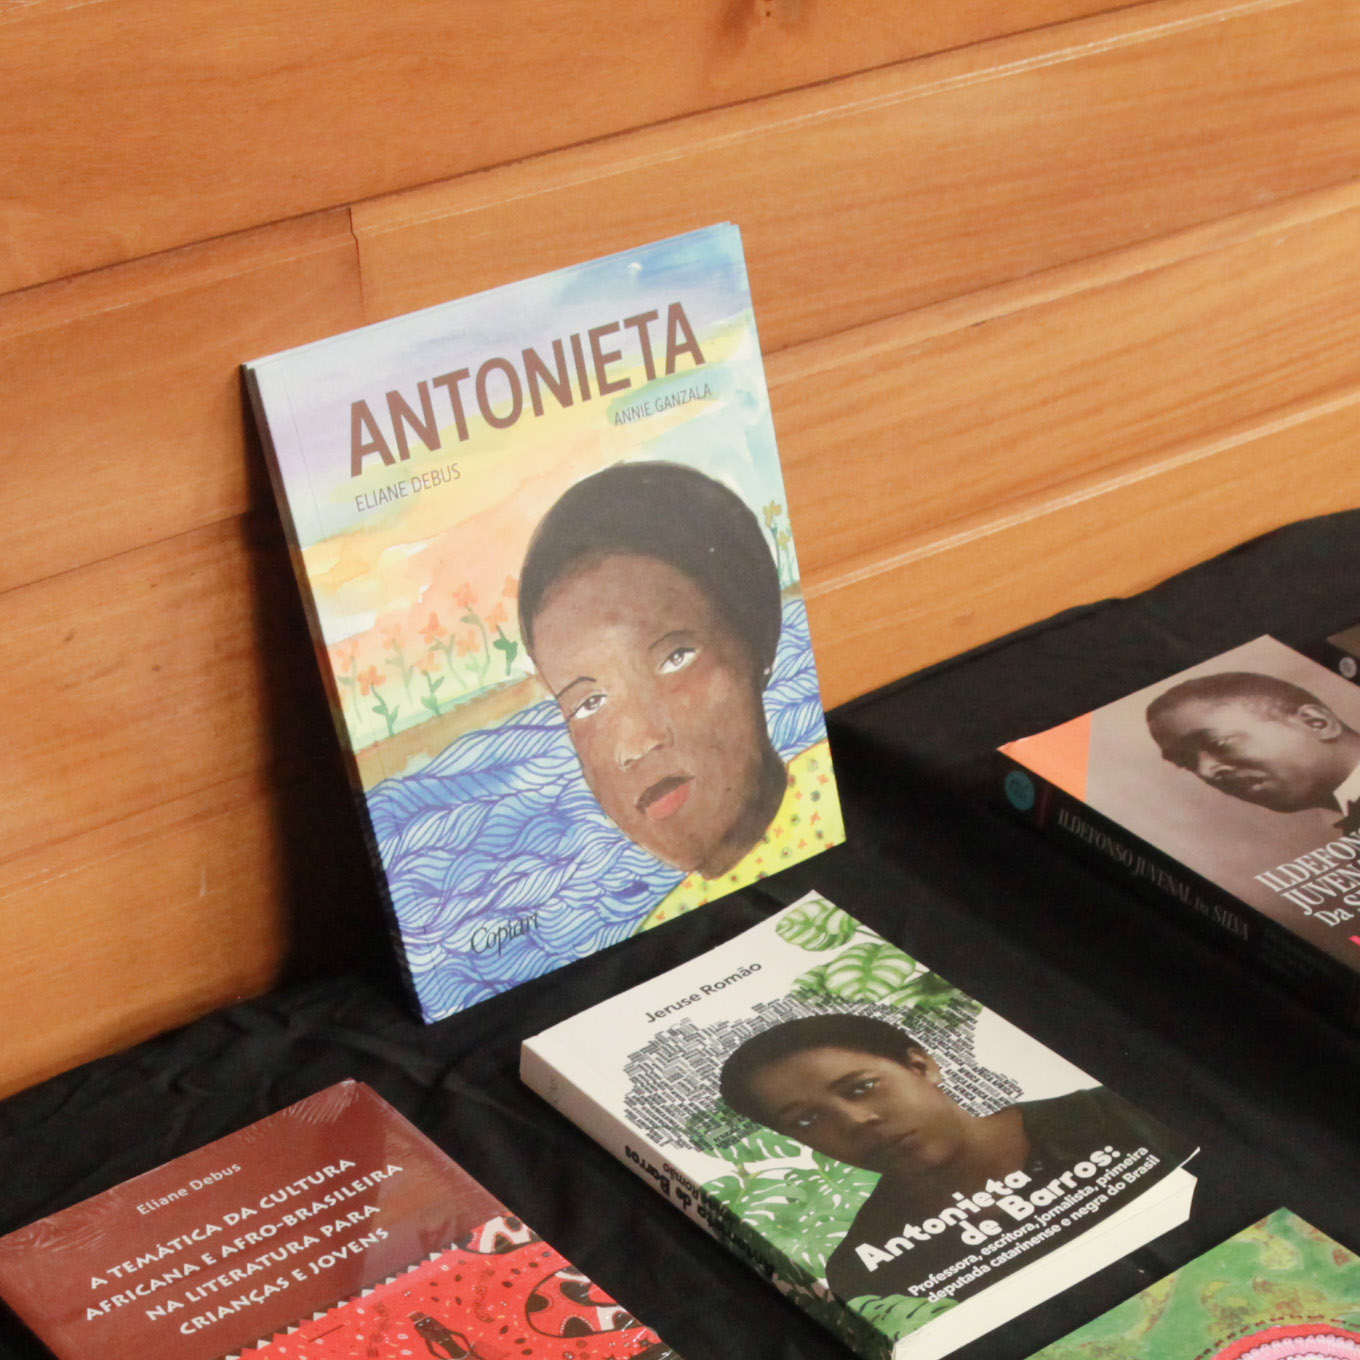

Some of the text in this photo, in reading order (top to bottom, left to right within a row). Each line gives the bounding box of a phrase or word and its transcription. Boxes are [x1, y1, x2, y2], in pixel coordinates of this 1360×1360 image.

[350, 301, 706, 478] ANTONIETA
[614, 383, 713, 427] ANNIE GANZALA
[355, 462, 461, 512] ELIANE DEBUS
[1057, 809, 1133, 867] ILDEFONSO
[1131, 855, 1192, 904] JUVENAL
[470, 910, 539, 956] Copiart
[645, 960, 762, 1023] Jeruse Romão
[136, 1162, 241, 1216] Eliane Debus
[625, 1145, 670, 1196] Barros
[854, 1170, 1032, 1273] Antonieta
[960, 1145, 1121, 1246] de Barros:
[86, 1164, 404, 1321] AFRICANA E AFRO-BRASILEIRA
[90, 1158, 356, 1289] A TEMÁTICA DA CULTURA
[145, 1204, 381, 1321] NA LITERATURA PARA
[907, 1147, 1149, 1297] Professora, escritora, jornalista, primeira
[927, 1154, 1161, 1304] deputada catarinense e negra do Brasil
[180, 1227, 390, 1335] CRIANÇAS E JOVENS
